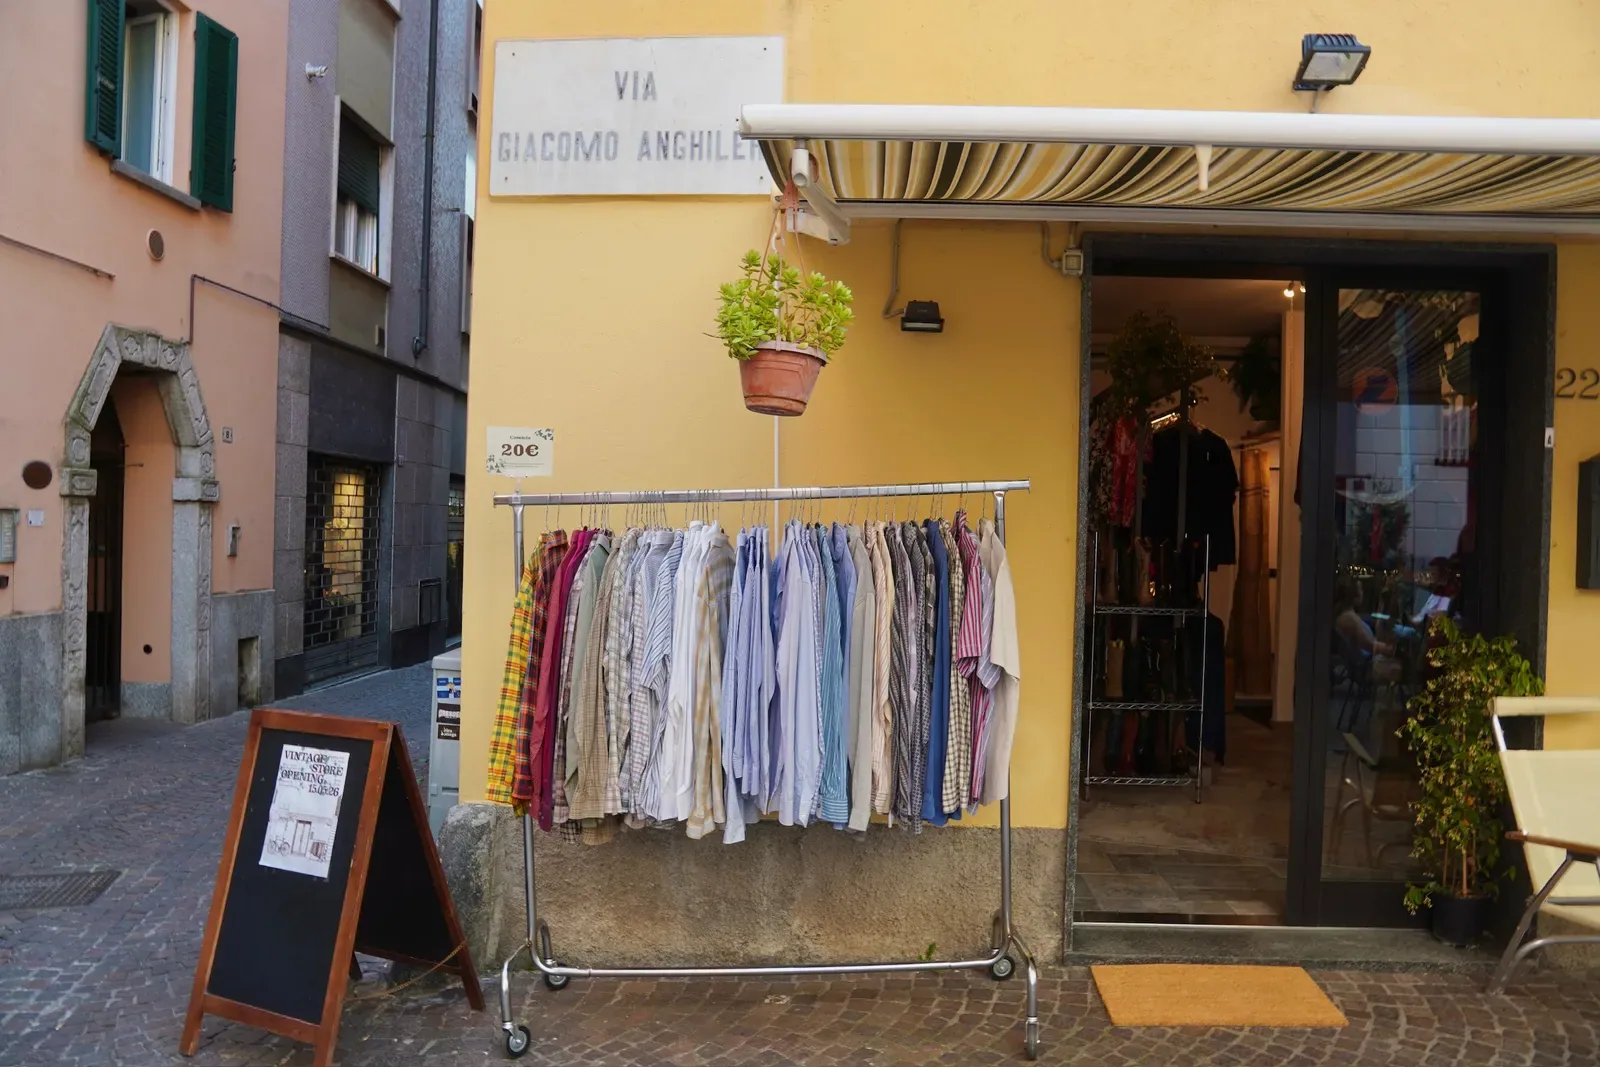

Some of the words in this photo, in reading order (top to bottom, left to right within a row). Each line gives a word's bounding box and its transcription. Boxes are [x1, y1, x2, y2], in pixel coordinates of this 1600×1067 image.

[614, 70, 658, 101] VIA
[498, 130, 619, 163] GIACOMO
[1556, 367, 1600, 399] 22
[501, 443, 540, 457] 20€
[284, 750, 327, 764] VINTAGE
[280, 769, 324, 785] OPENING
[311, 763, 344, 777] STORE
